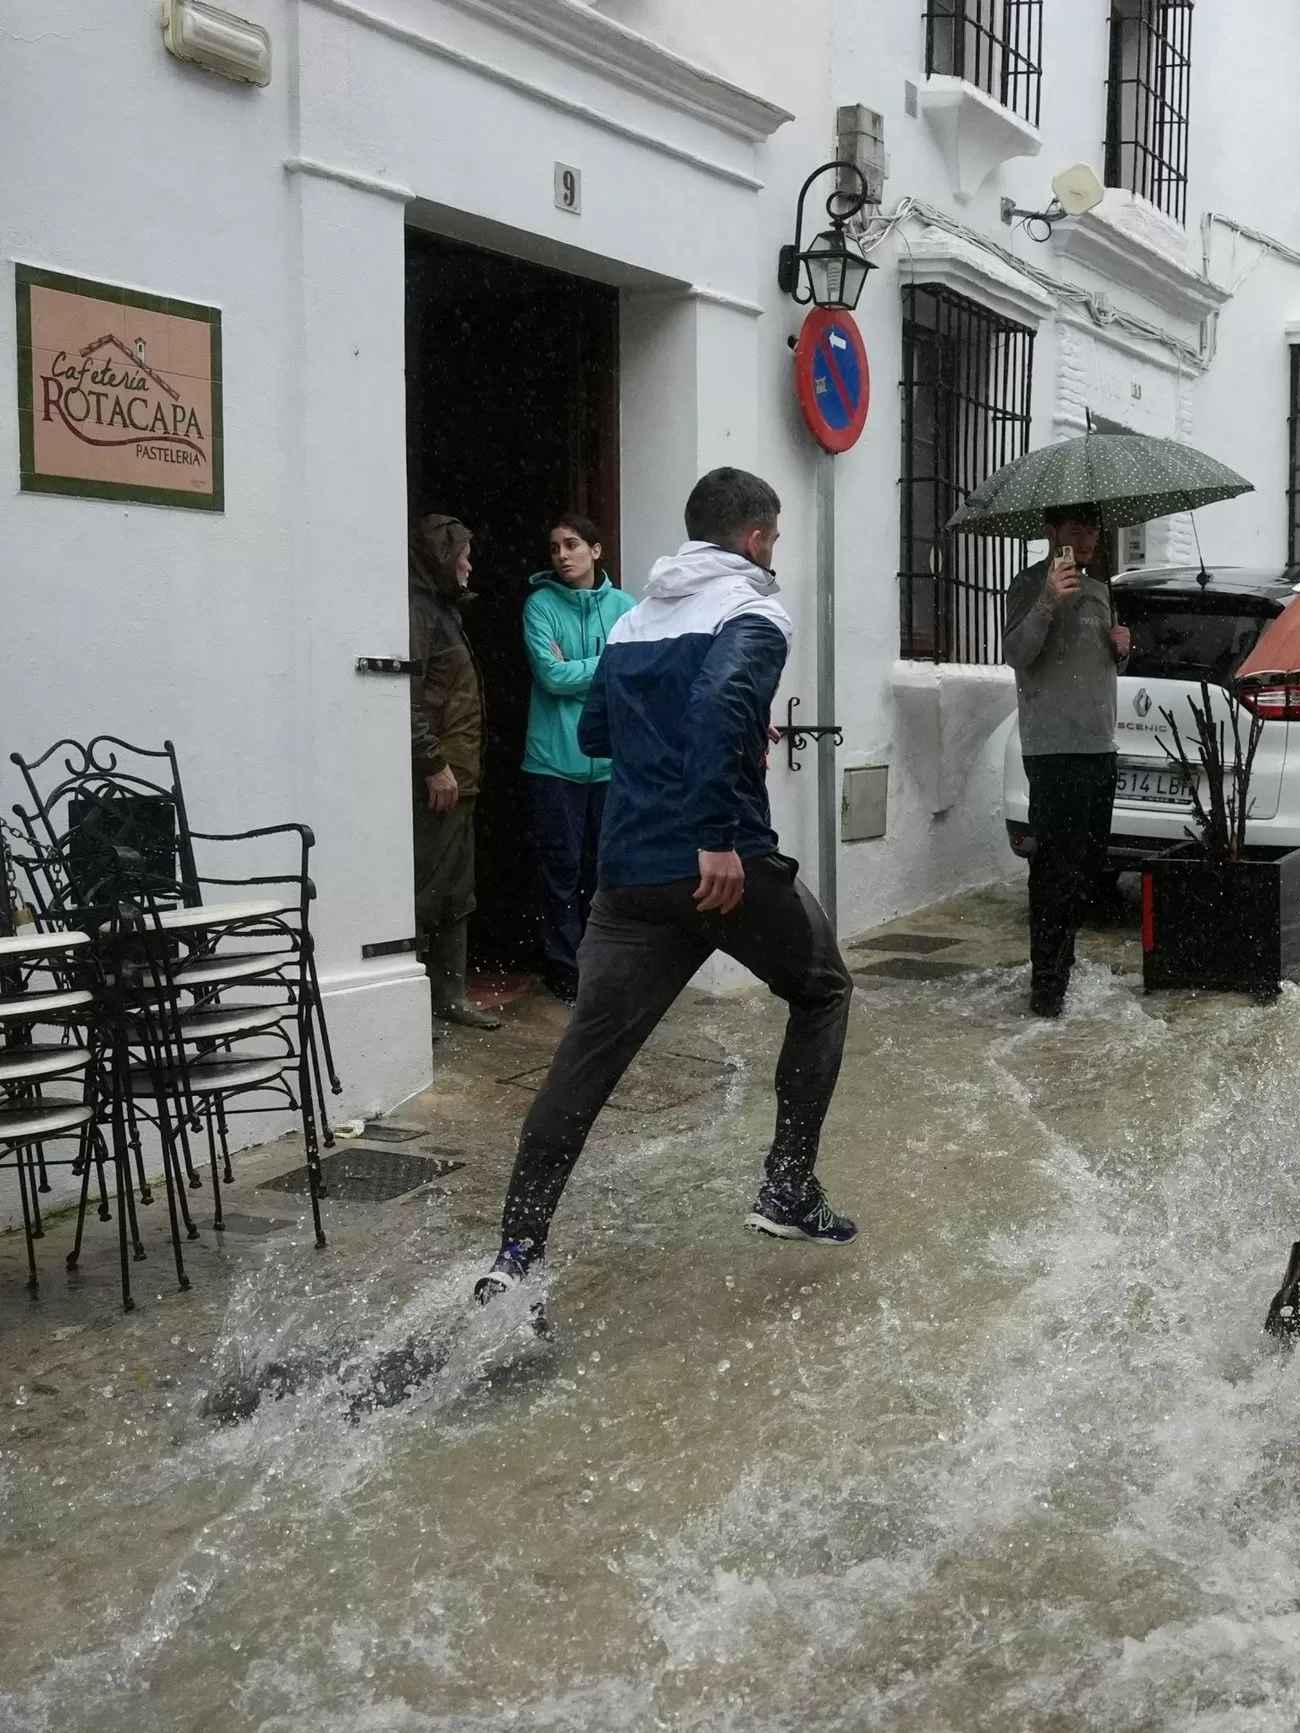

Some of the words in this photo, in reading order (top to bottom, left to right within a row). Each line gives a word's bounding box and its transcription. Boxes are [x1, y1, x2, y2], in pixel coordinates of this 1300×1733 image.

[562, 169, 575, 207] 9
[52, 351, 149, 392] Cafetería
[40, 375, 205, 440] ROTACAPA
[136, 444, 201, 466] PASTELERIA
[1117, 721, 1167, 732] SCENIC
[1116, 771, 1150, 793] 514
